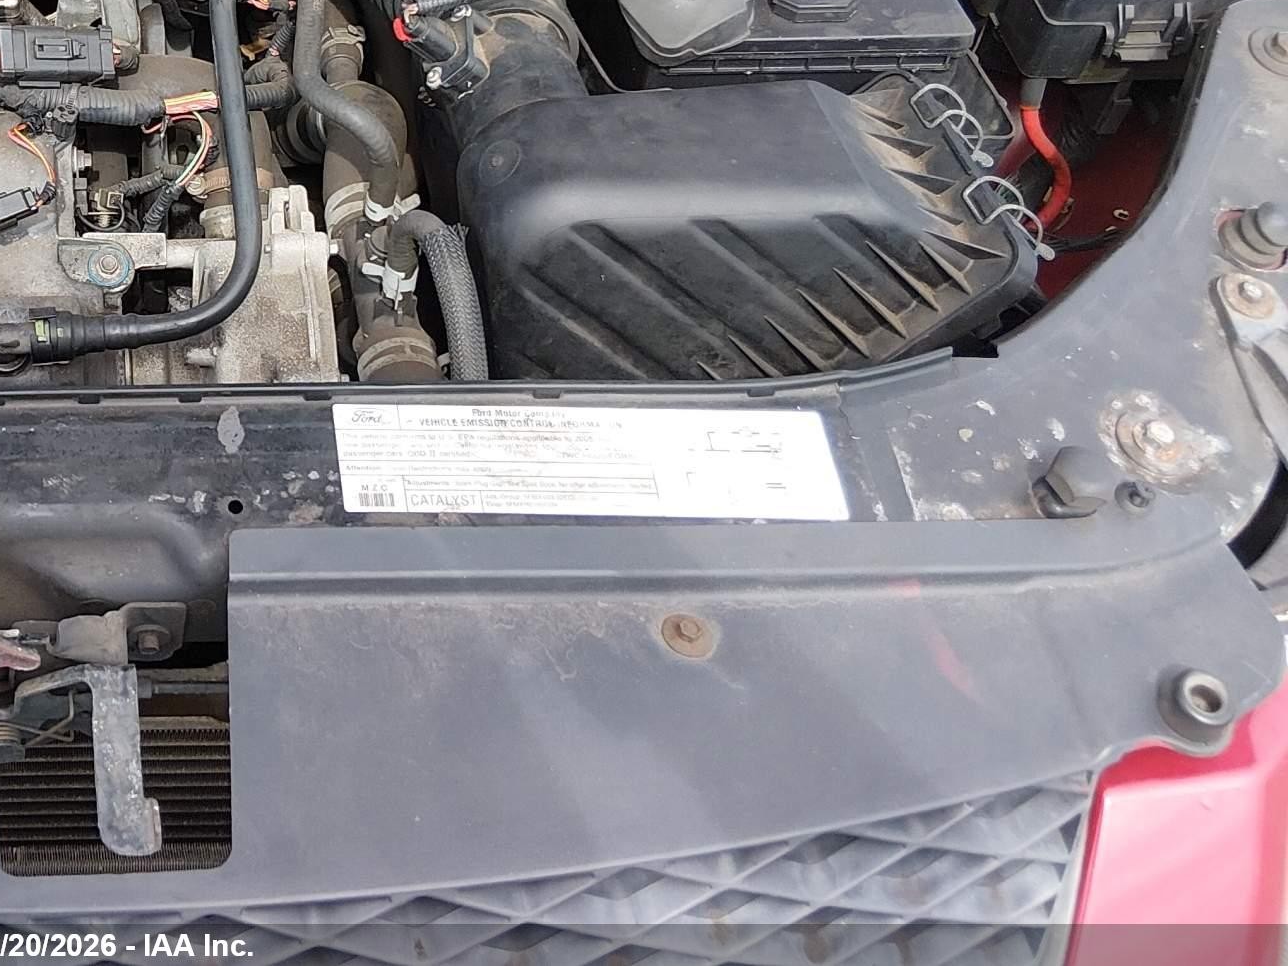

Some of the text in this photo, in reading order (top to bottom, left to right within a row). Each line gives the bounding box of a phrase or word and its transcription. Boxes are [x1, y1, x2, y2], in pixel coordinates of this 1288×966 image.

[351, 410, 383, 424] Ford
[472, 408, 492, 417] Ford
[495, 409, 521, 417] Motor
[418, 418, 458, 427] VEHICLE
[460, 418, 507, 427] EMISSION
[411, 494, 476, 506] CATALYST
